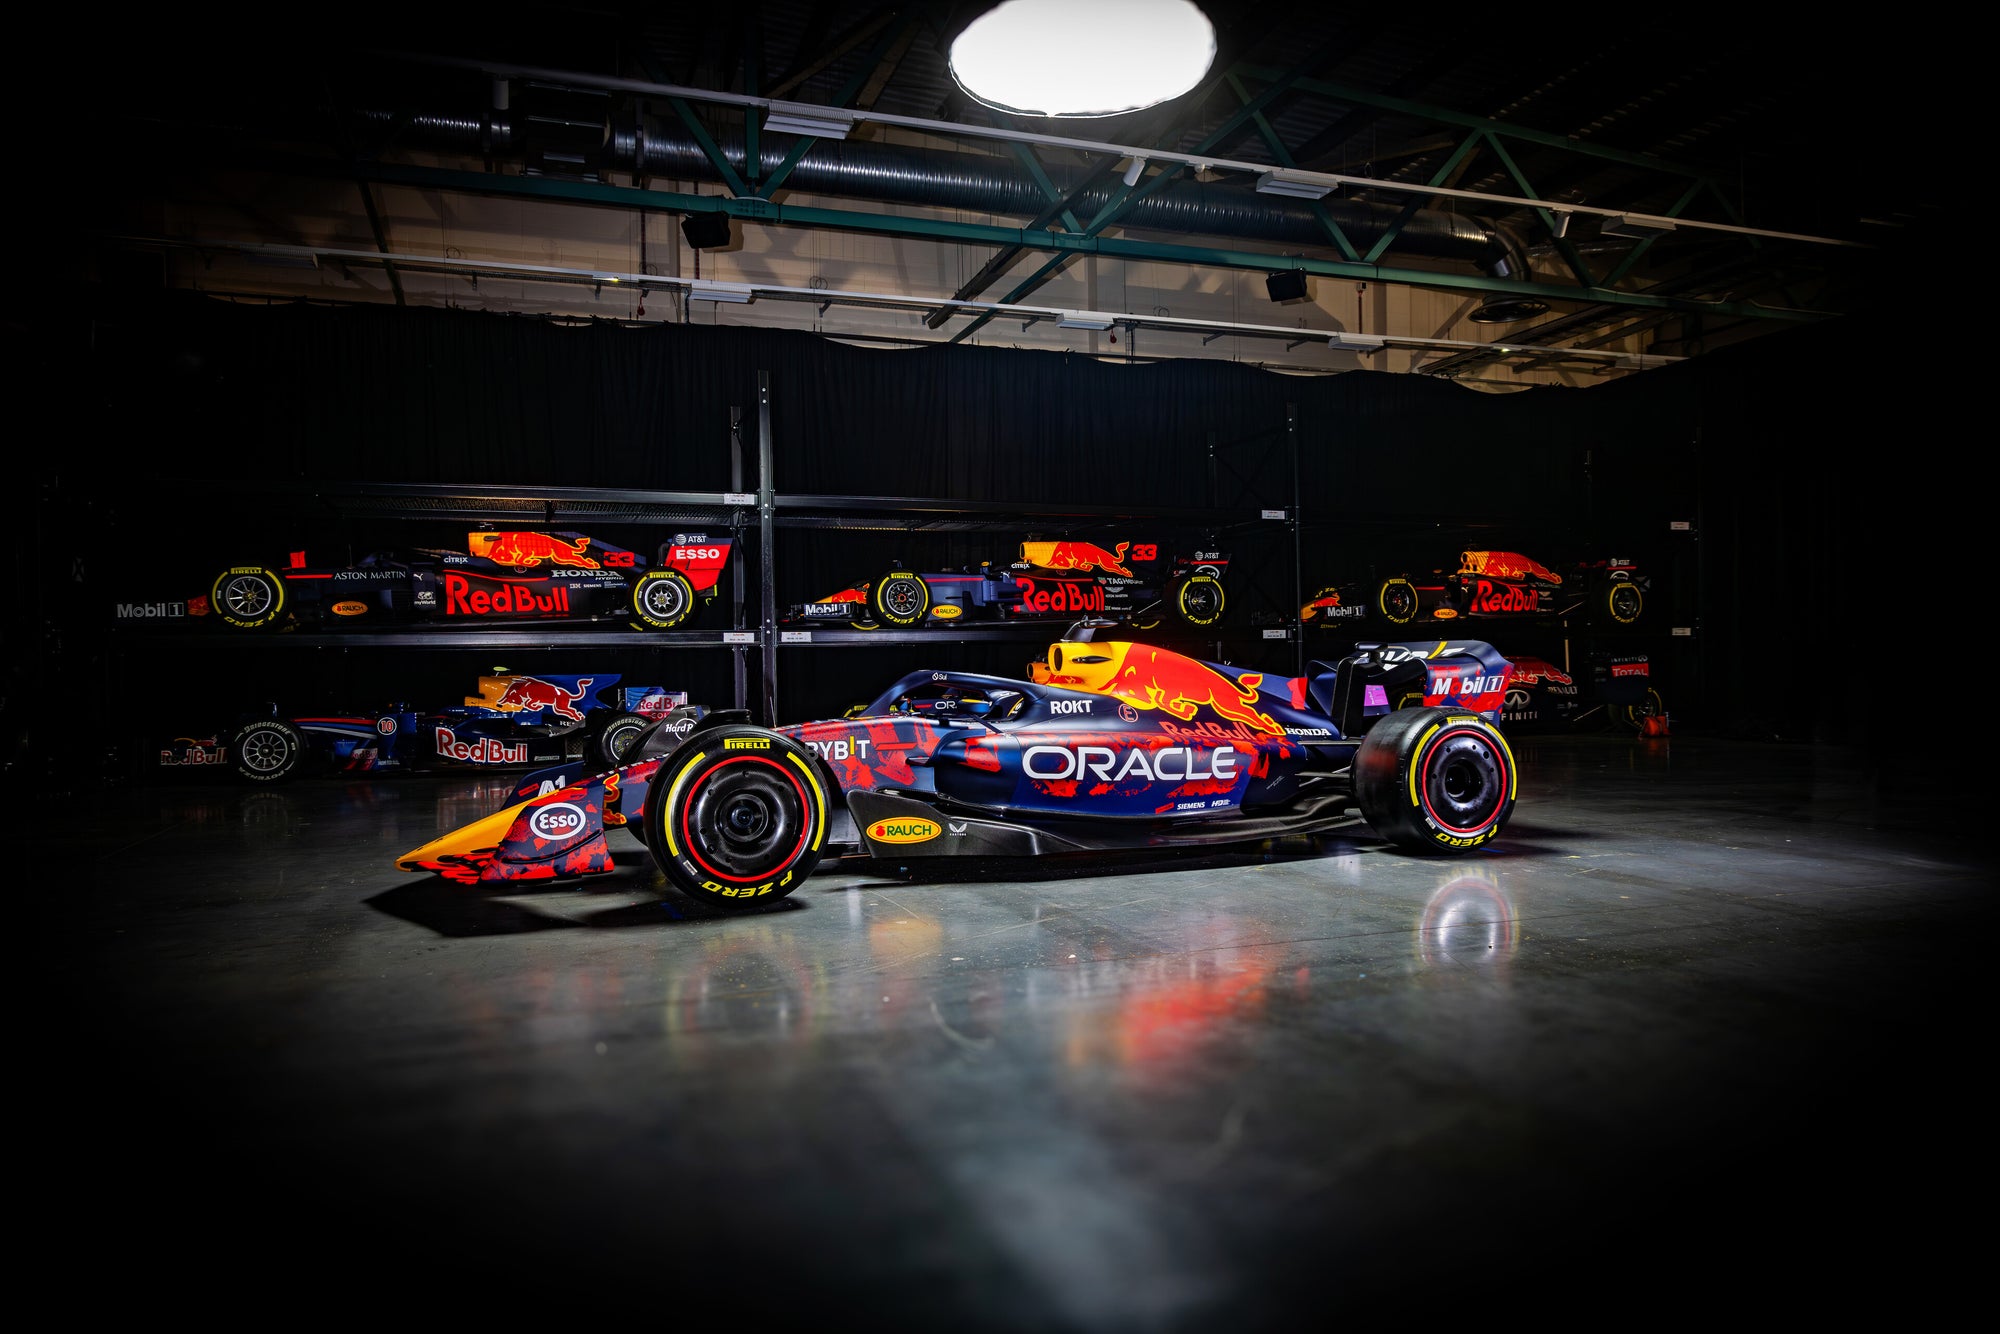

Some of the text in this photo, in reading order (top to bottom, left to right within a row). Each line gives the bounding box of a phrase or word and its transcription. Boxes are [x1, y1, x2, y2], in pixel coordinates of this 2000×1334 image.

[676, 549, 720, 559] ESSO
[1131, 544, 1157, 560] 33
[603, 551, 635, 567] 33
[334, 571, 406, 580] ASTON MARTIN
[116, 603, 166, 618] Mobil
[805, 603, 838, 616] Mobil
[1327, 606, 1352, 617] Mobil
[223, 616, 264, 628] ZERO
[1432, 676, 1485, 695] Mobil
[1050, 700, 1093, 714] ROKT
[1500, 711, 1539, 721] FINITI
[665, 724, 686, 732] Hard
[1284, 727, 1332, 736] HONDA
[723, 738, 771, 750] PIRELLI
[804, 736, 871, 761] BYBIT
[1022, 745, 1237, 781] ORACLE
[1177, 802, 1206, 810] SIEMENS
[887, 825, 932, 836] RAUCH
[1436, 824, 1498, 847] P ZERO
[701, 870, 793, 898] P ZERO
